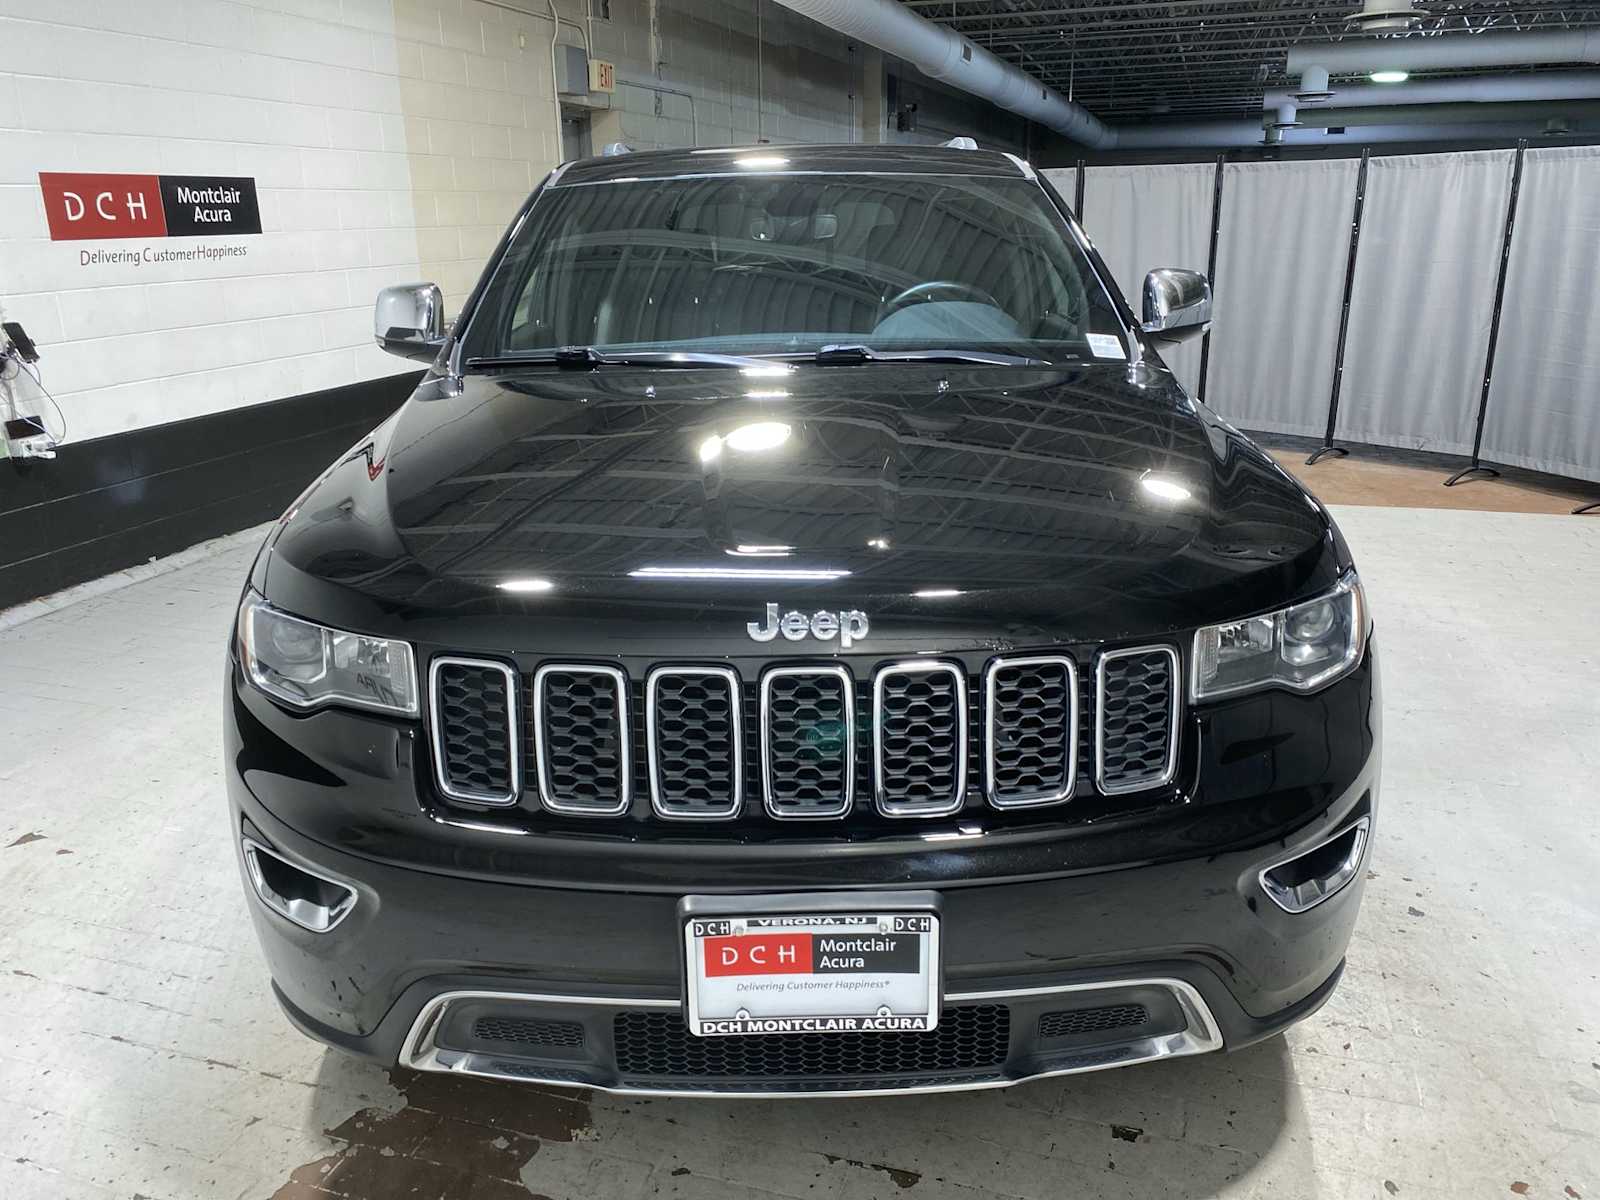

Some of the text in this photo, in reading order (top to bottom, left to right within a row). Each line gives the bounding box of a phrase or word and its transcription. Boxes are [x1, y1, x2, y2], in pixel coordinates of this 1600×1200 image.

[600, 63, 613, 88] EXIT
[177, 186, 241, 204] Montclair
[63, 191, 148, 221] DCH
[194, 206, 232, 222] Acura
[80, 245, 247, 267] Delivering Customer Happiness
[746, 602, 870, 648] Jeep
[844, 916, 867, 924] NJ
[895, 918, 930, 931] DCH
[695, 922, 730, 936] DCH
[819, 938, 897, 953] Montclair
[721, 945, 796, 966] DCH
[819, 955, 865, 969] Acura
[736, 982, 785, 993] Delivering
[787, 981, 833, 990] Customer
[703, 1018, 925, 1034] DCH MONTCLAIR ACURA
